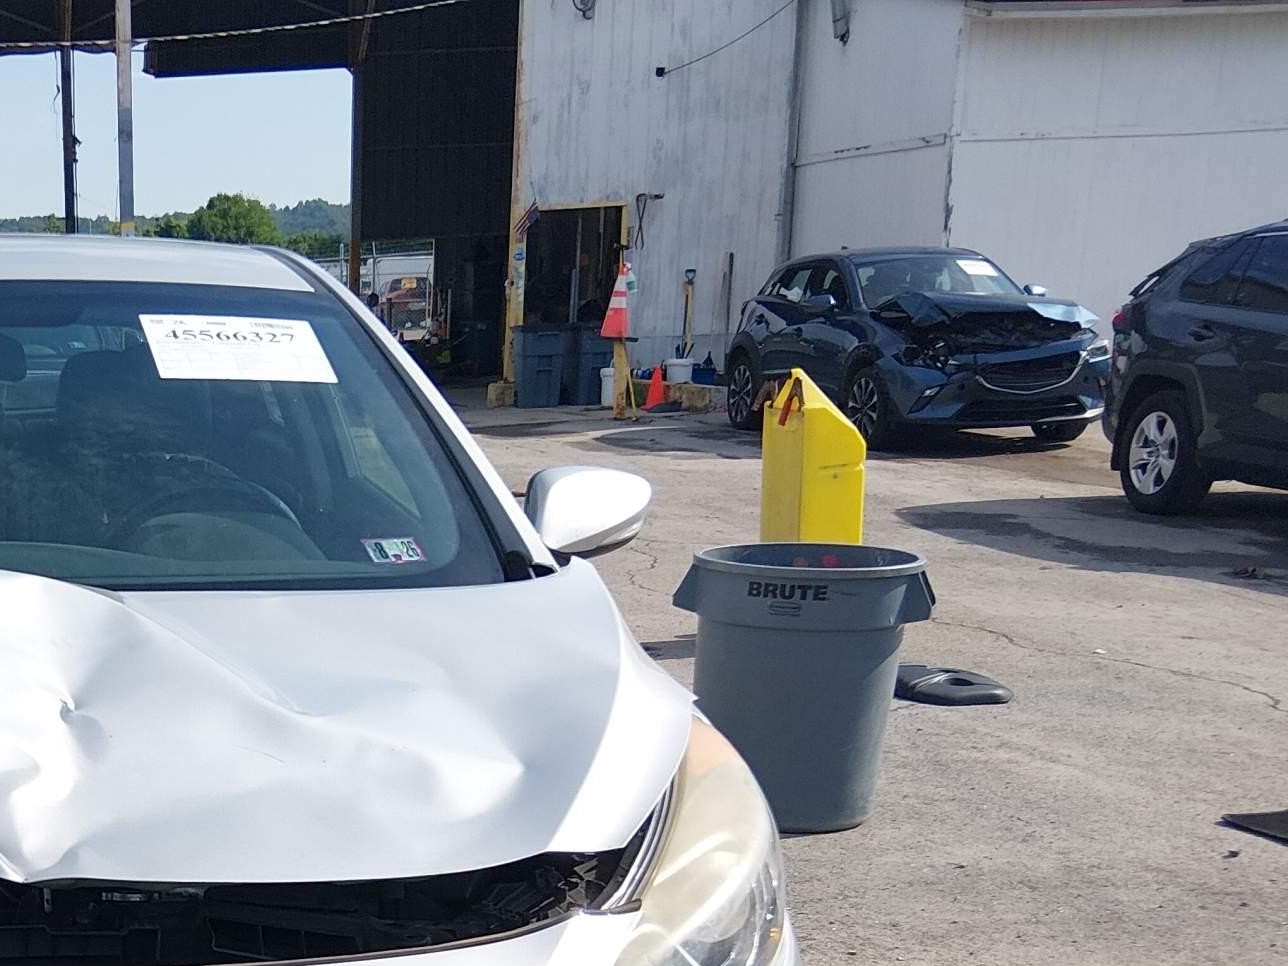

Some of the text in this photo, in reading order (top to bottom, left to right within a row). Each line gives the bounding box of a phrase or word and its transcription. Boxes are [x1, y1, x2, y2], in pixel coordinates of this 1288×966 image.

[164, 329, 295, 344] 45566327
[374, 541, 420, 559] 8 26
[747, 581, 830, 601] BRUTE
